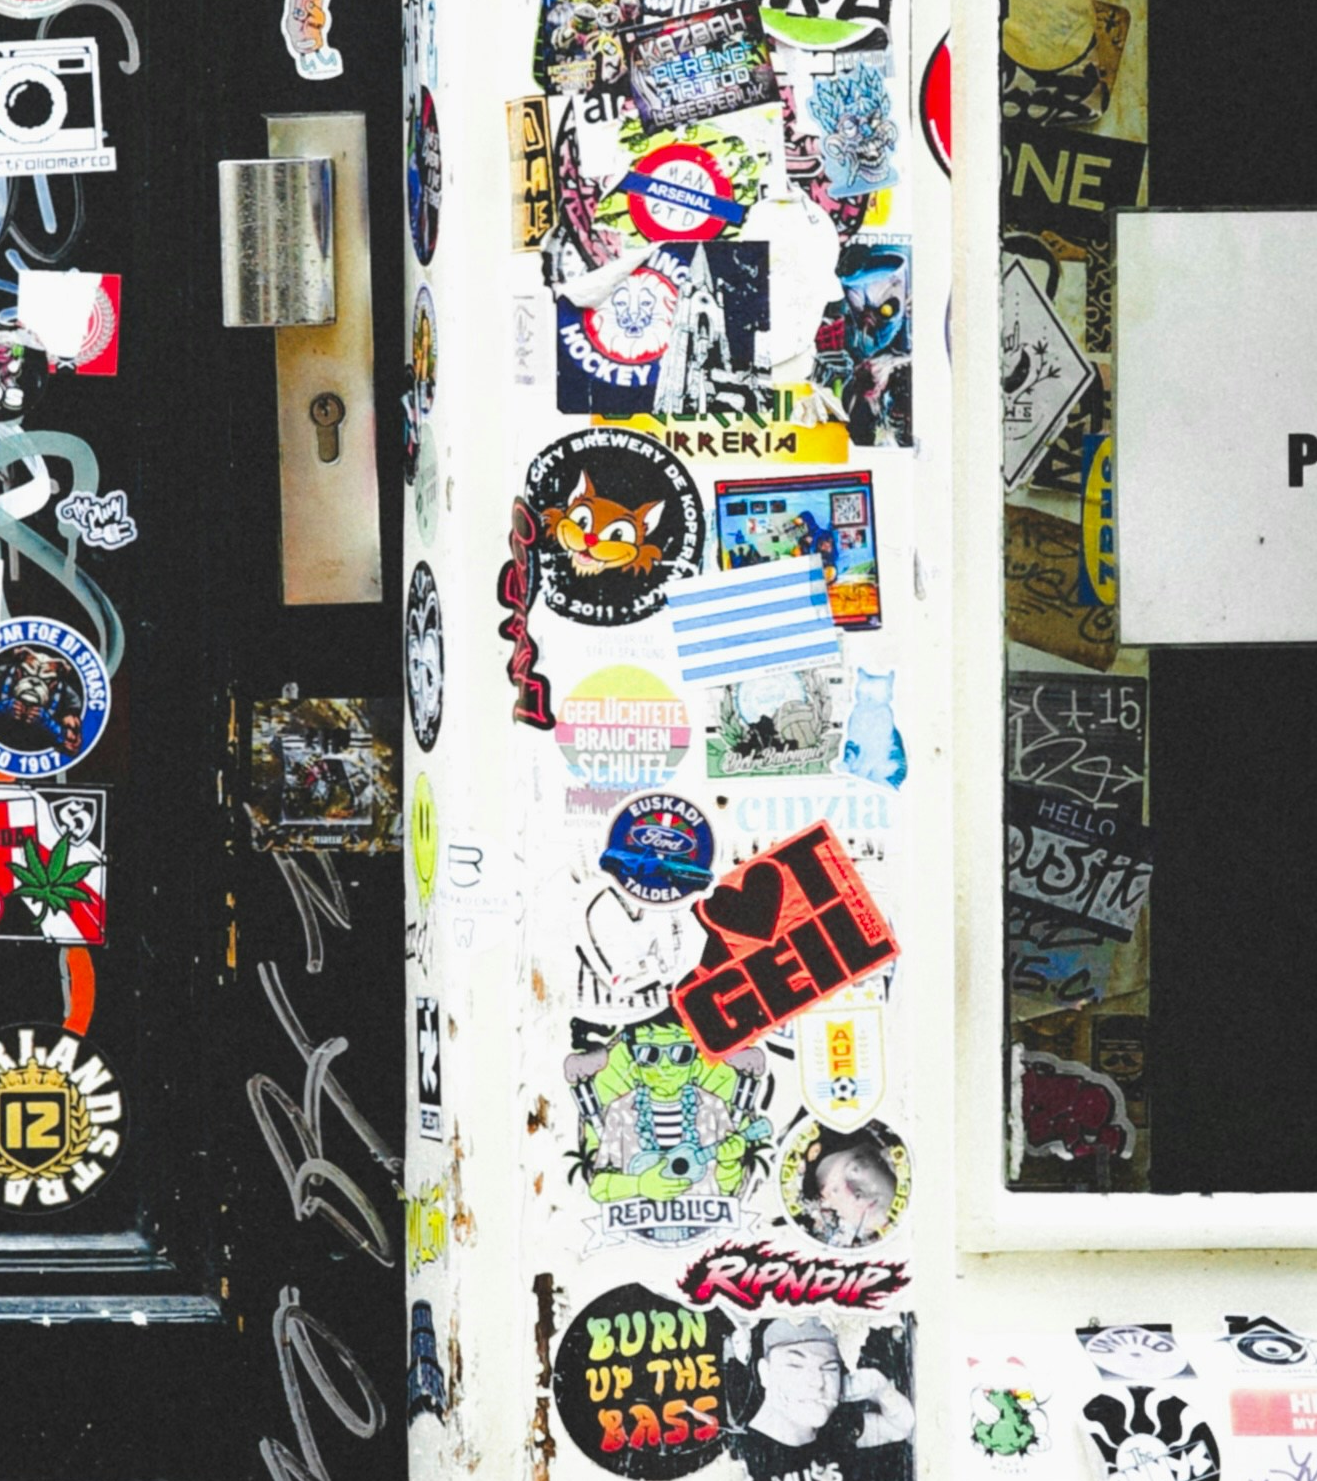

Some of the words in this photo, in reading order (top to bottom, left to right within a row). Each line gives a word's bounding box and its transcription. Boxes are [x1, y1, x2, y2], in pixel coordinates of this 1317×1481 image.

[647, 180, 713, 212] ARSENAL
[570, 600, 614, 620] 2011
[566, 699, 687, 725] GEFLÜCHTETE
[574, 726, 671, 751] BRAUCHEN
[17, 752, 63, 774] 1907
[577, 753, 671, 784] SCHUTZ
[1037, 798, 1116, 839] HELLO
[622, 876, 682, 903] TALDEA
[5, 1100, 61, 1150] 12
[608, 1199, 735, 1228] REPUBLICA
[585, 1311, 707, 1363] BURN
[585, 1366, 636, 1403] UP
[645, 1353, 721, 1394] THE
[595, 1396, 722, 1452] BASS
